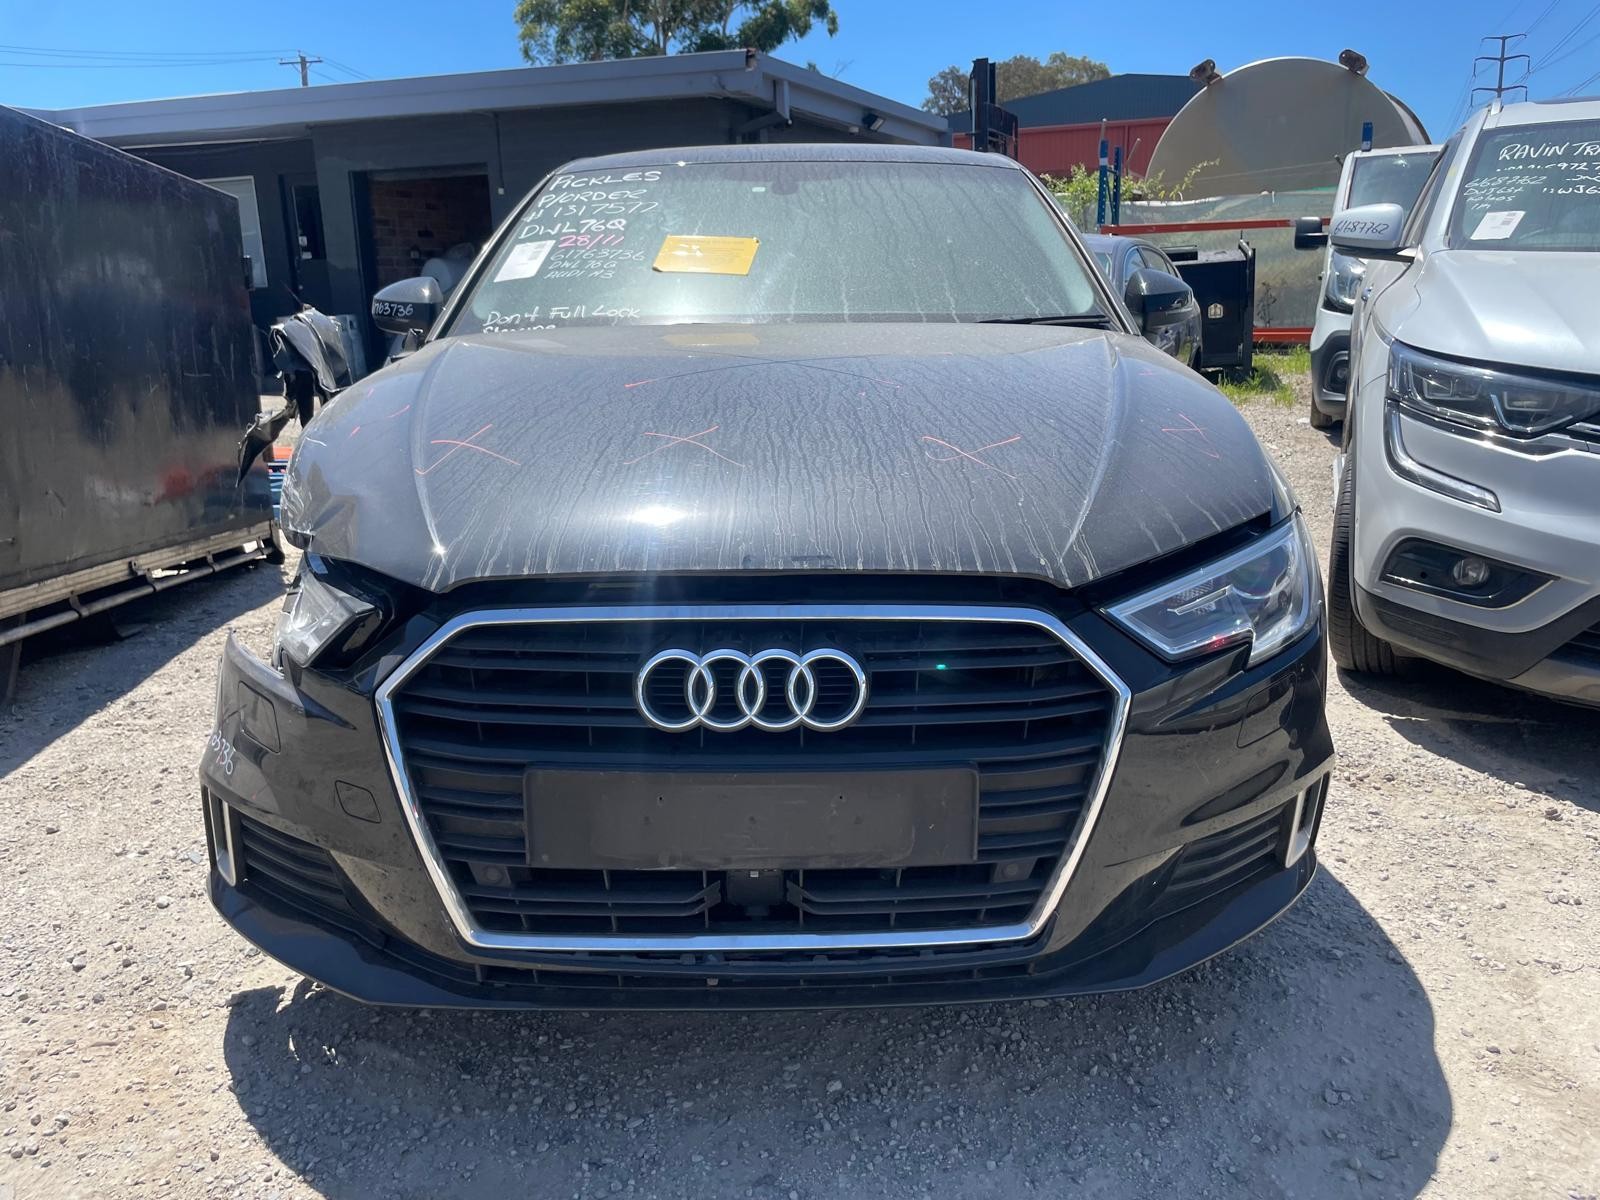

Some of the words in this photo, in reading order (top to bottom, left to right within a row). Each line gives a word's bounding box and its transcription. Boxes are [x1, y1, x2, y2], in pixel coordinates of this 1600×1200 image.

[1498, 141, 1570, 161] RAVIN
[549, 170, 662, 192] PICKLES
[558, 233, 625, 250] 28/11
[549, 304, 585, 319] Full
